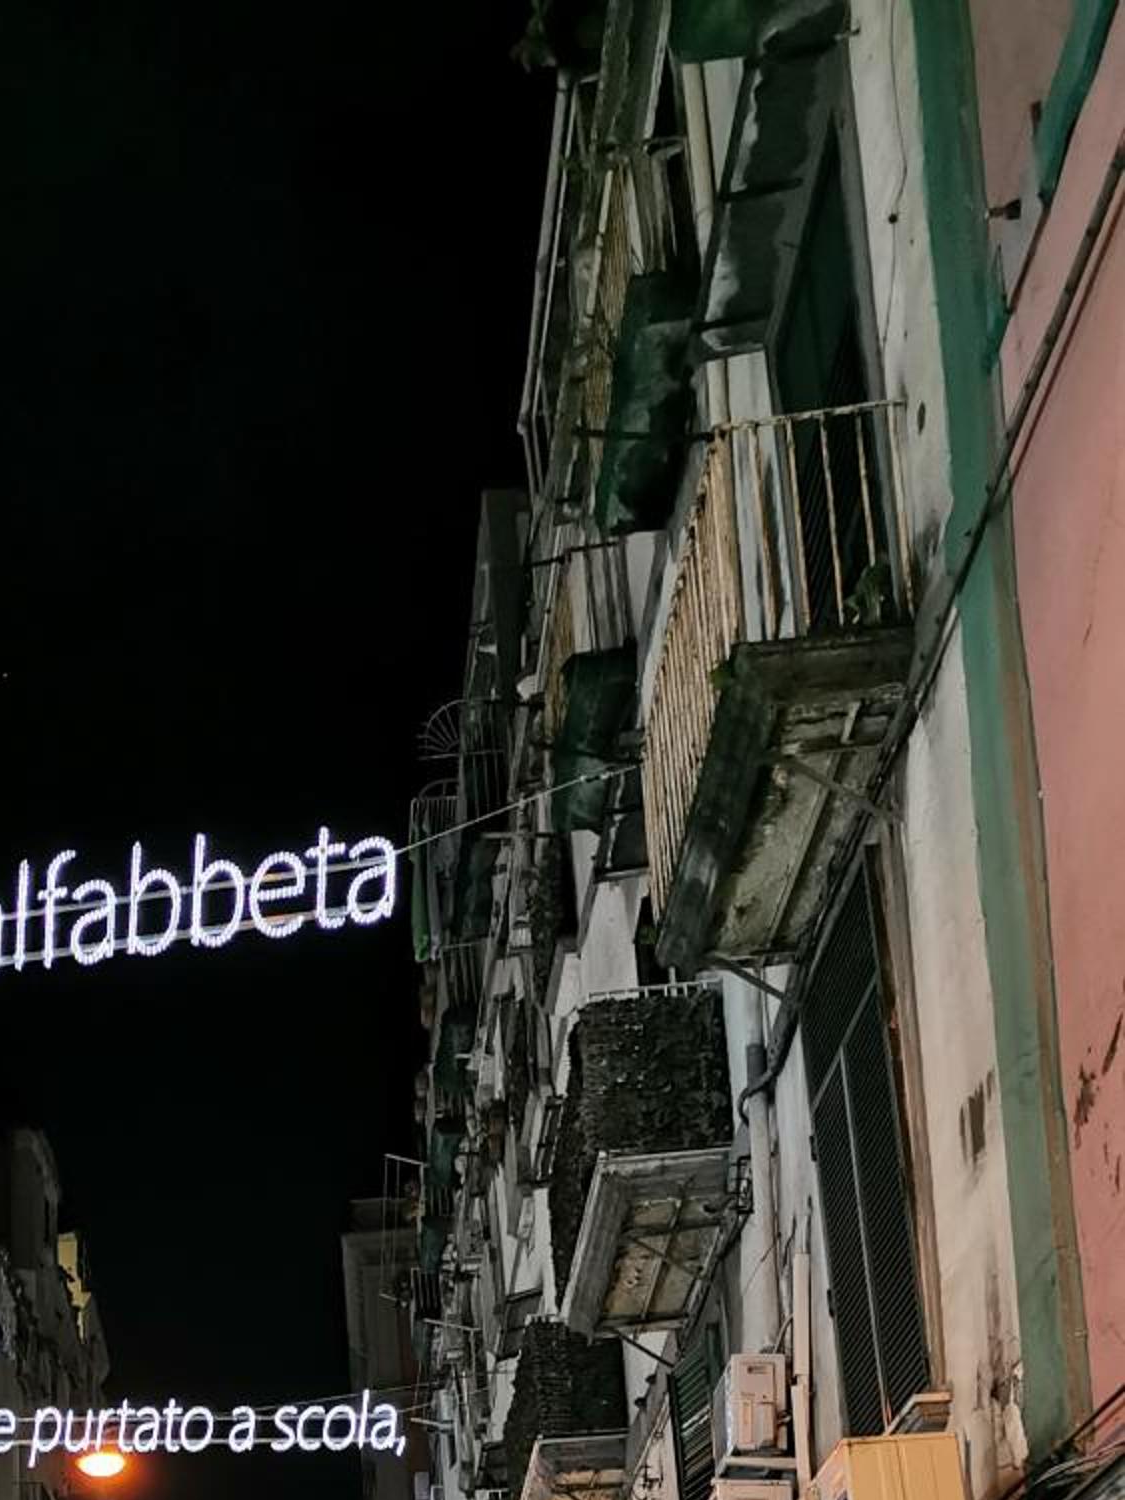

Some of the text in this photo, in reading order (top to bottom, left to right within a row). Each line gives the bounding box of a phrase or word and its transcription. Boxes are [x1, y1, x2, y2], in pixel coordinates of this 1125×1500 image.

[28, 1397, 215, 1469] purtato
[228, 1405, 256, 1454] a
[270, 1389, 406, 1457] scola,
